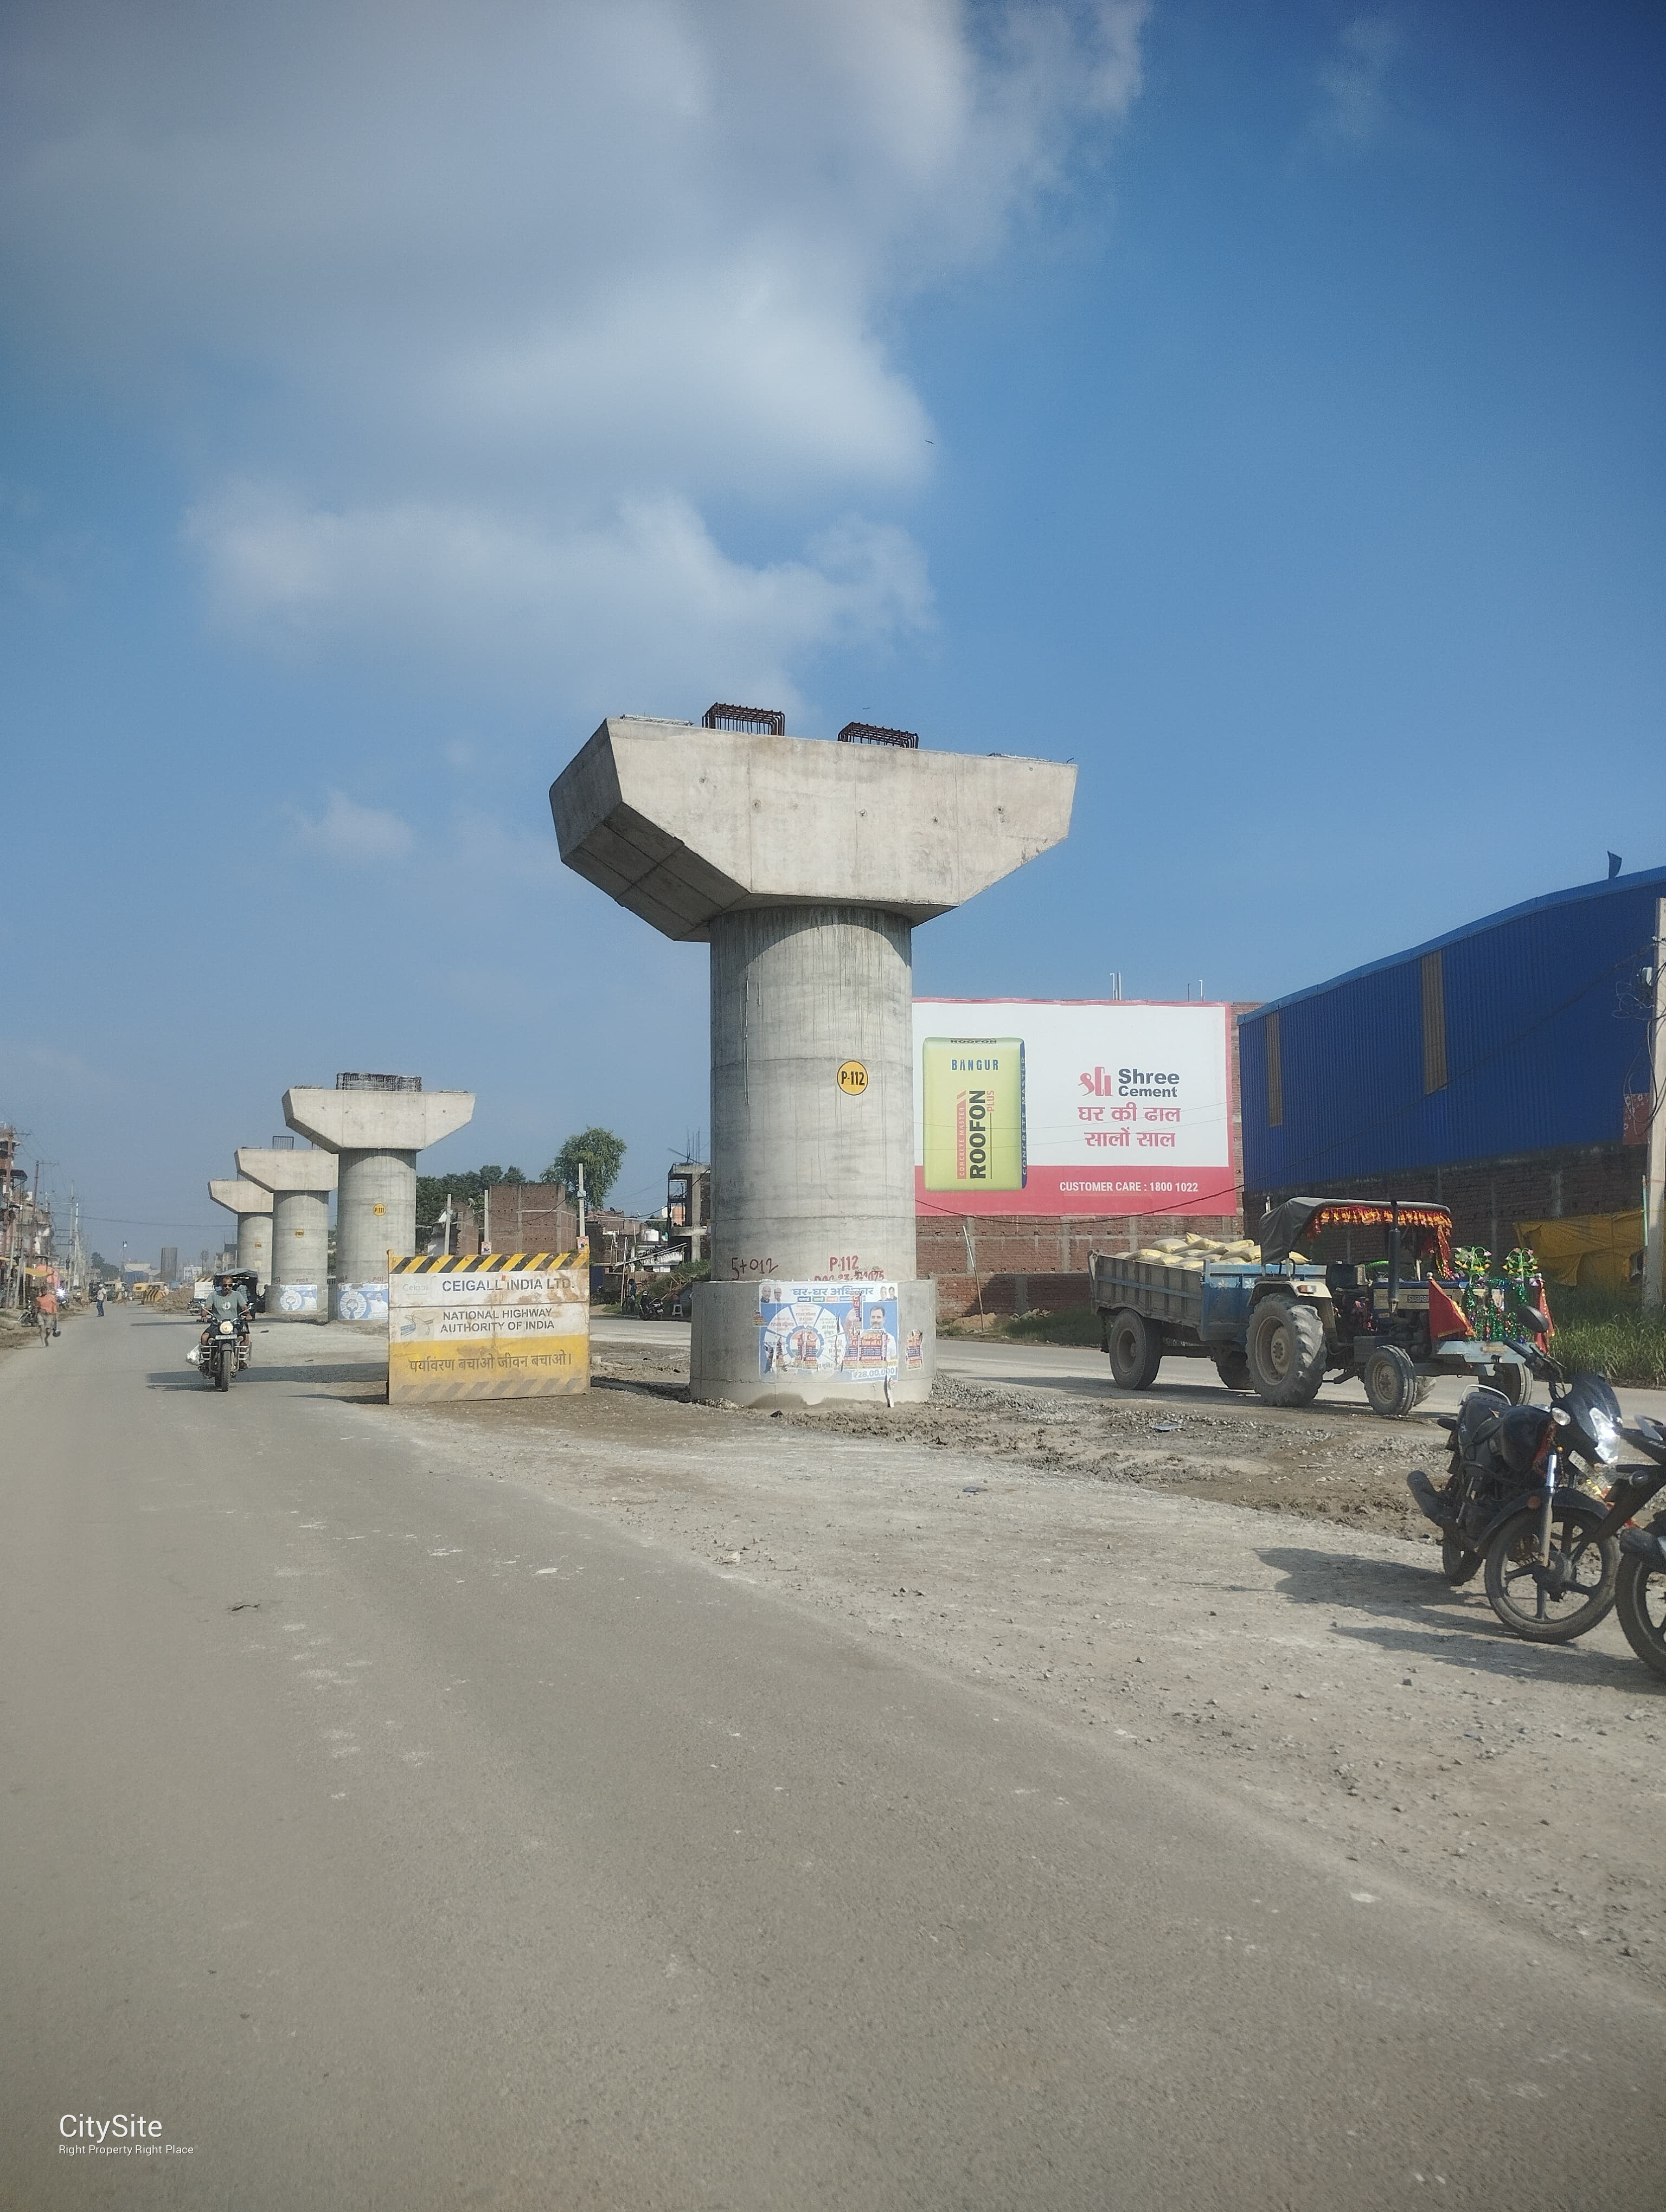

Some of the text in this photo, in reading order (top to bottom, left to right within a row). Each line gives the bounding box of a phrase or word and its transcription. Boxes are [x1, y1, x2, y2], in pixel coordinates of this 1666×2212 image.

[951, 1059, 998, 1071] BANGUR
[841, 1071, 865, 1086] P-112
[1118, 1069, 1180, 1085] Shree
[1118, 1085, 1178, 1098] Cement
[986, 1090, 995, 1112] PLUS
[1077, 1102, 1181, 1122] घर की ढाल
[969, 1090, 986, 1179] ROOFON
[1084, 1127, 1176, 1147] सालों साल
[1059, 1182, 1113, 1191] CUSTOMER
[1116, 1182, 1141, 1191] CARE
[1150, 1182, 1172, 1192] 1800
[1175, 1182, 1198, 1192] 1022
[442, 1277, 575, 1292] CEIGALL INDIA LTD.
[443, 1308, 552, 1321] NATIONAL HIGHWAY
[440, 1320, 555, 1333] AUTHORITY OF INDIA
[458, 1353, 495, 1371] बचाओ
[498, 1352, 528, 1369] जीवन
